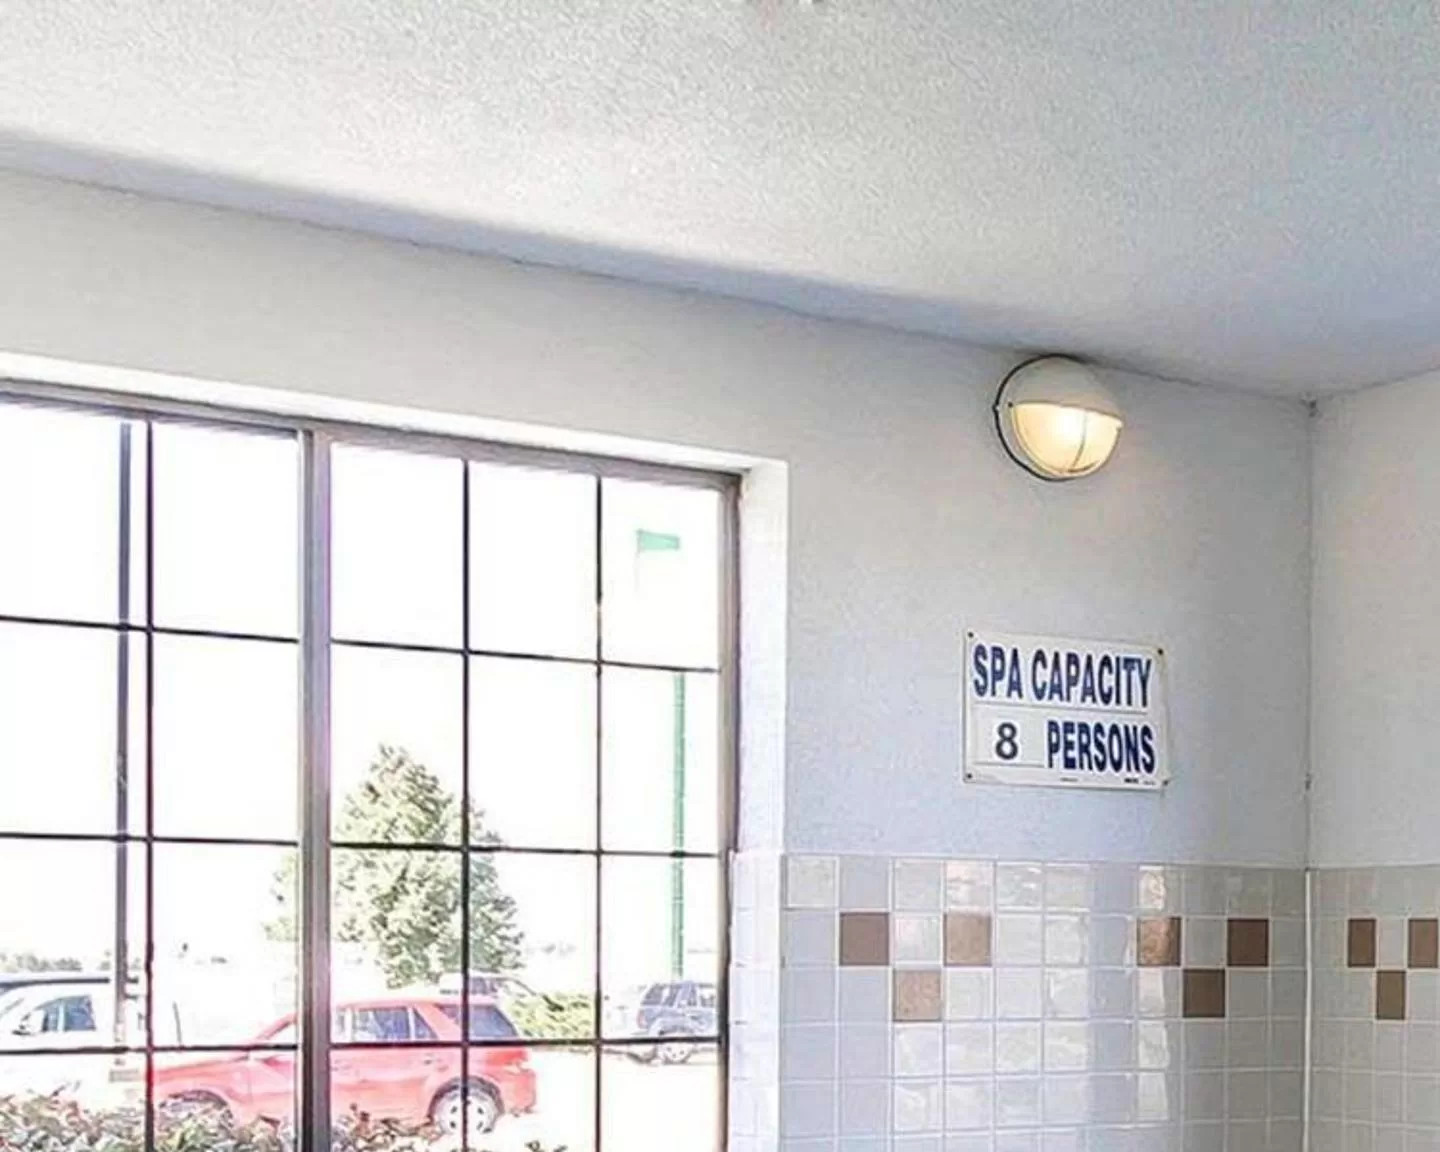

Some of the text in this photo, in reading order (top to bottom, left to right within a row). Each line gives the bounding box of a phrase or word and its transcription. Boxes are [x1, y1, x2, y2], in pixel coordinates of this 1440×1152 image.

[974, 644, 1152, 708] SPA CAPACITY
[995, 720, 1155, 775] 8 PERSONS
